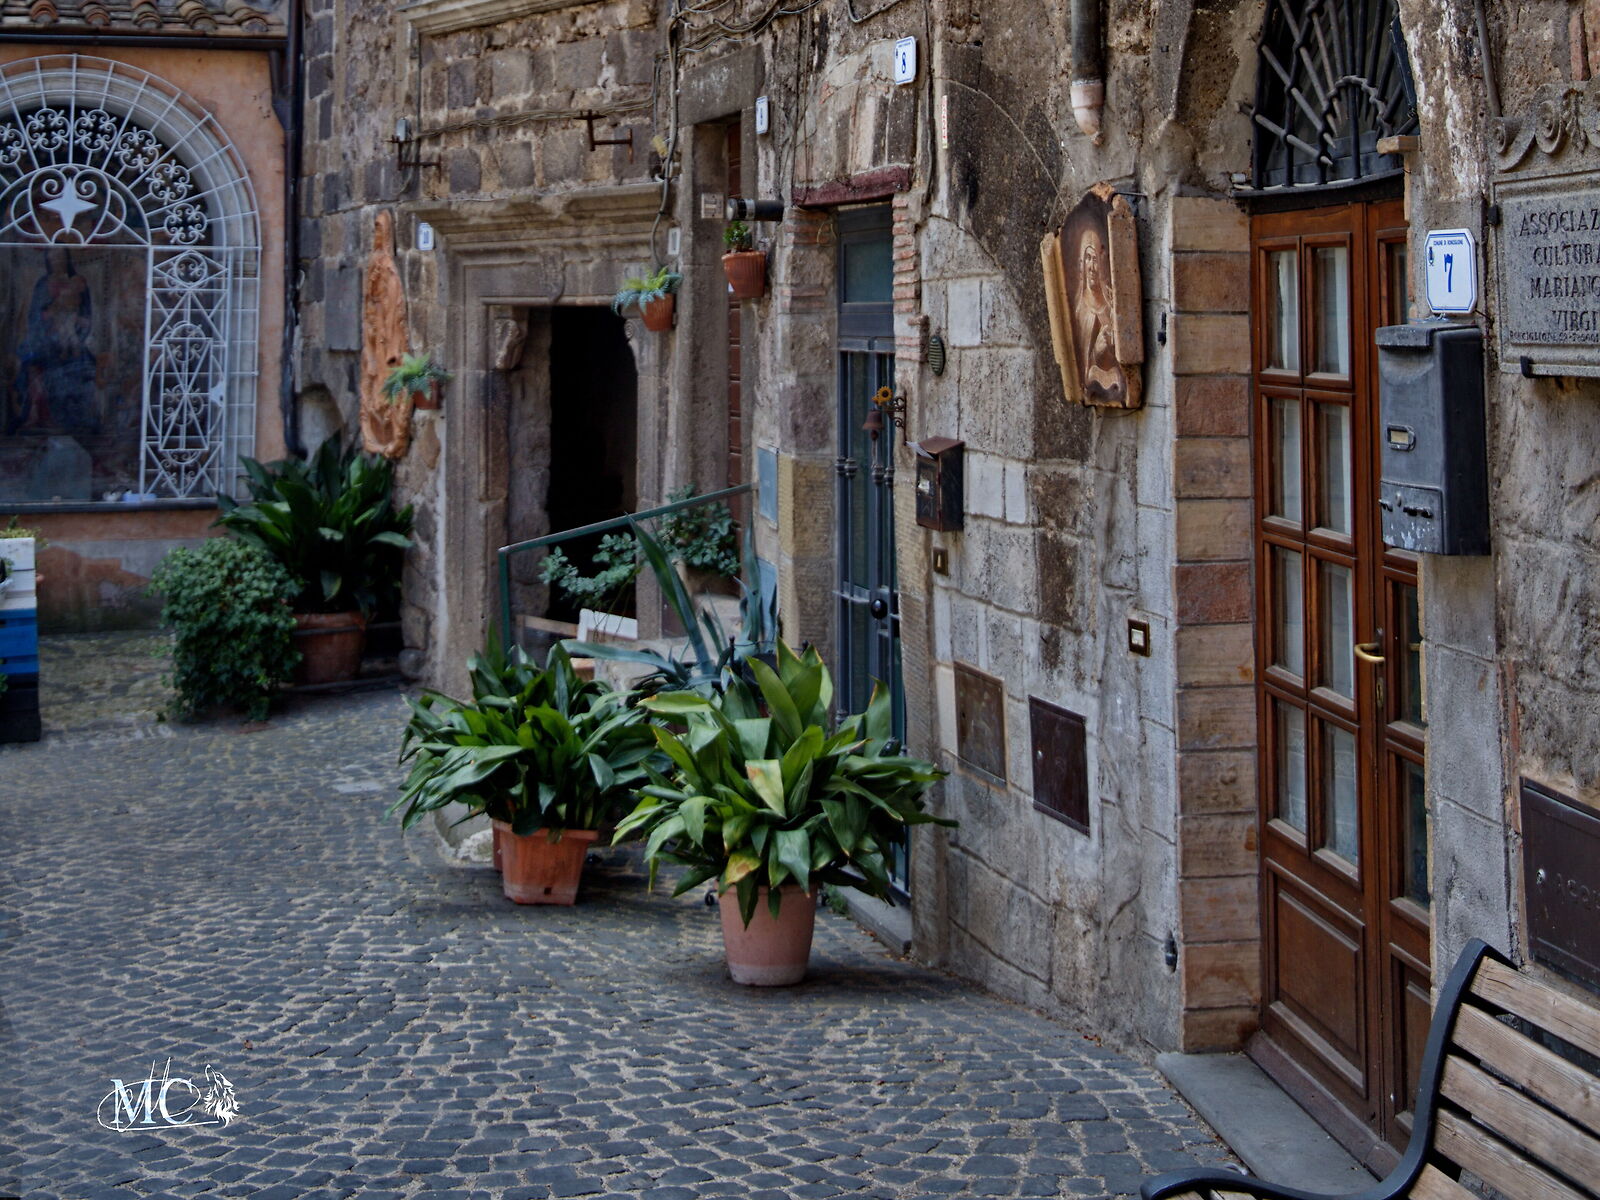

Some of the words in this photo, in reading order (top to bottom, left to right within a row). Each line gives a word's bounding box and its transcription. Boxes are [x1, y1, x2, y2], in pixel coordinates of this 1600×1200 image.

[901, 51, 907, 74] 8
[1519, 208, 1600, 237] ASSOCIAZ
[1443, 253, 1454, 293] 7
